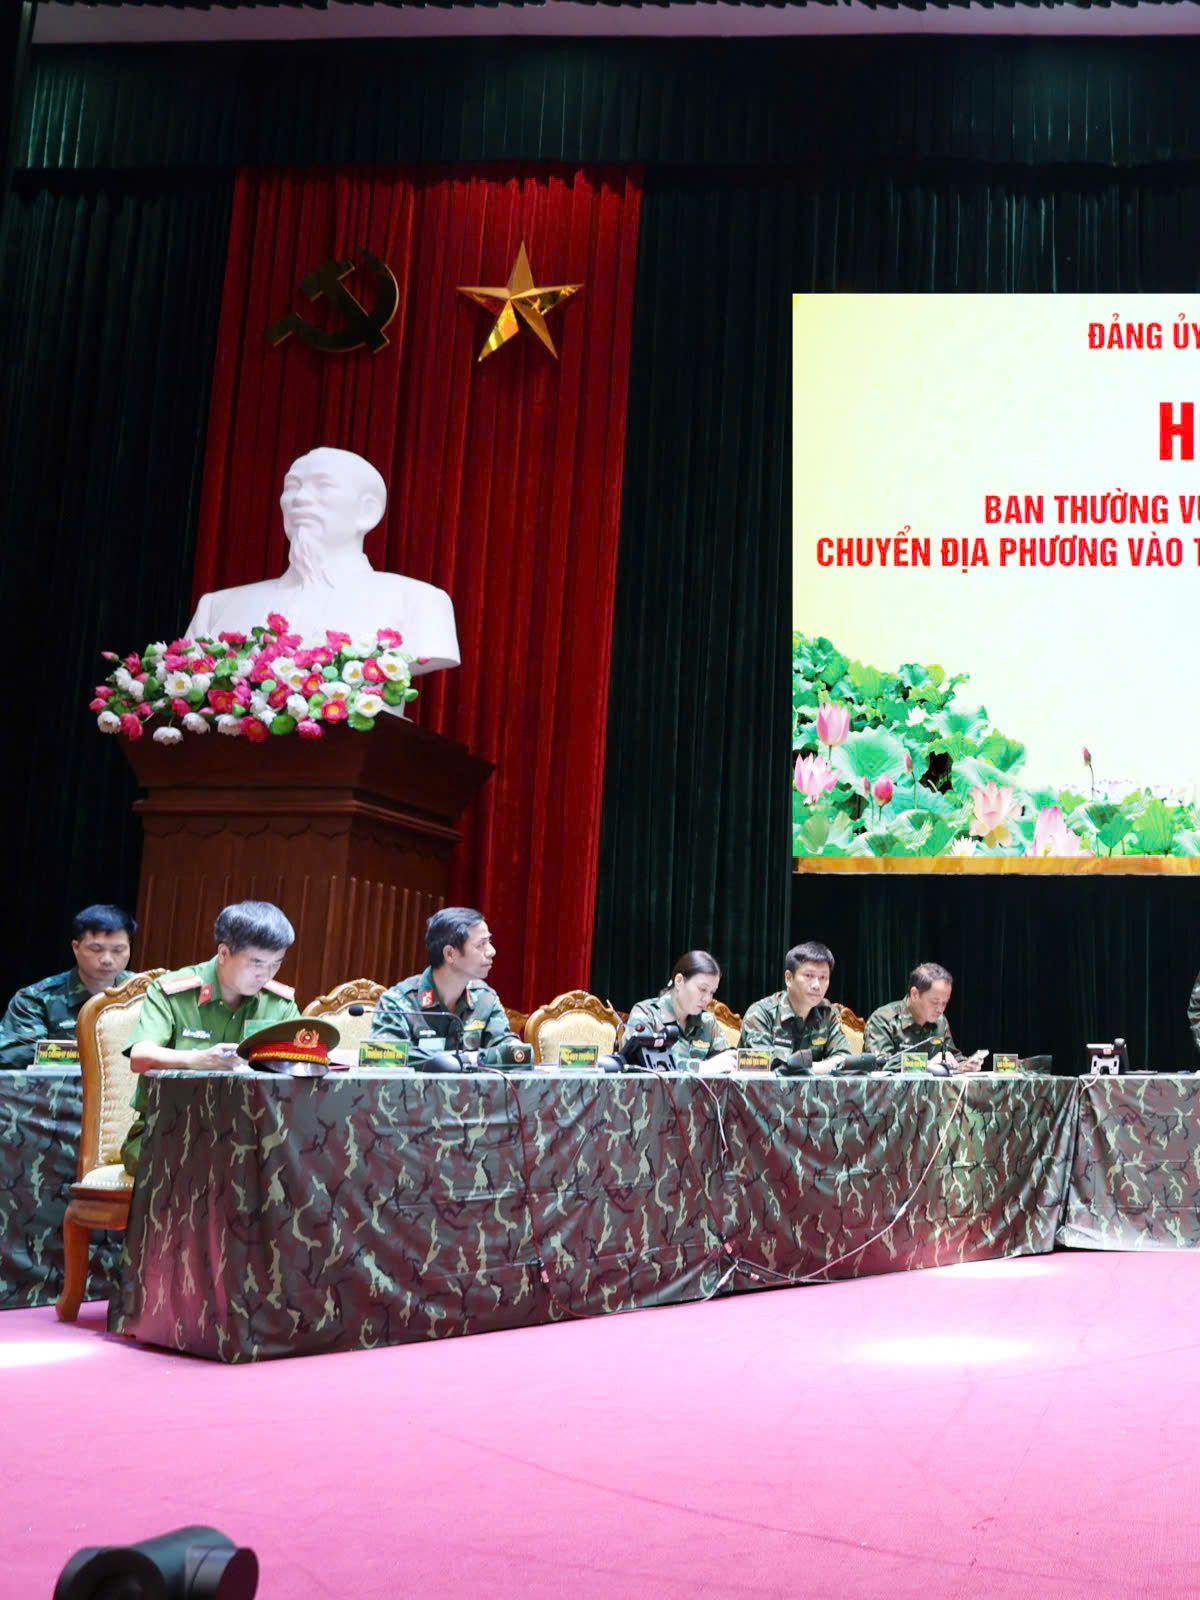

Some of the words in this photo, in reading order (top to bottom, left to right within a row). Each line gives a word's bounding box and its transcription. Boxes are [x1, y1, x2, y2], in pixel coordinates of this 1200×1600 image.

[1088, 313, 1162, 349] ĐẢNG
[985, 495, 1043, 525] BAN
[1054, 487, 1168, 525] THƯỜNG
[817, 525, 930, 567] CHUYỂN
[940, 538, 989, 573] ĐỊA
[1000, 535, 1117, 567] PHƯƠNG
[1128, 531, 1182, 567] VÀO
